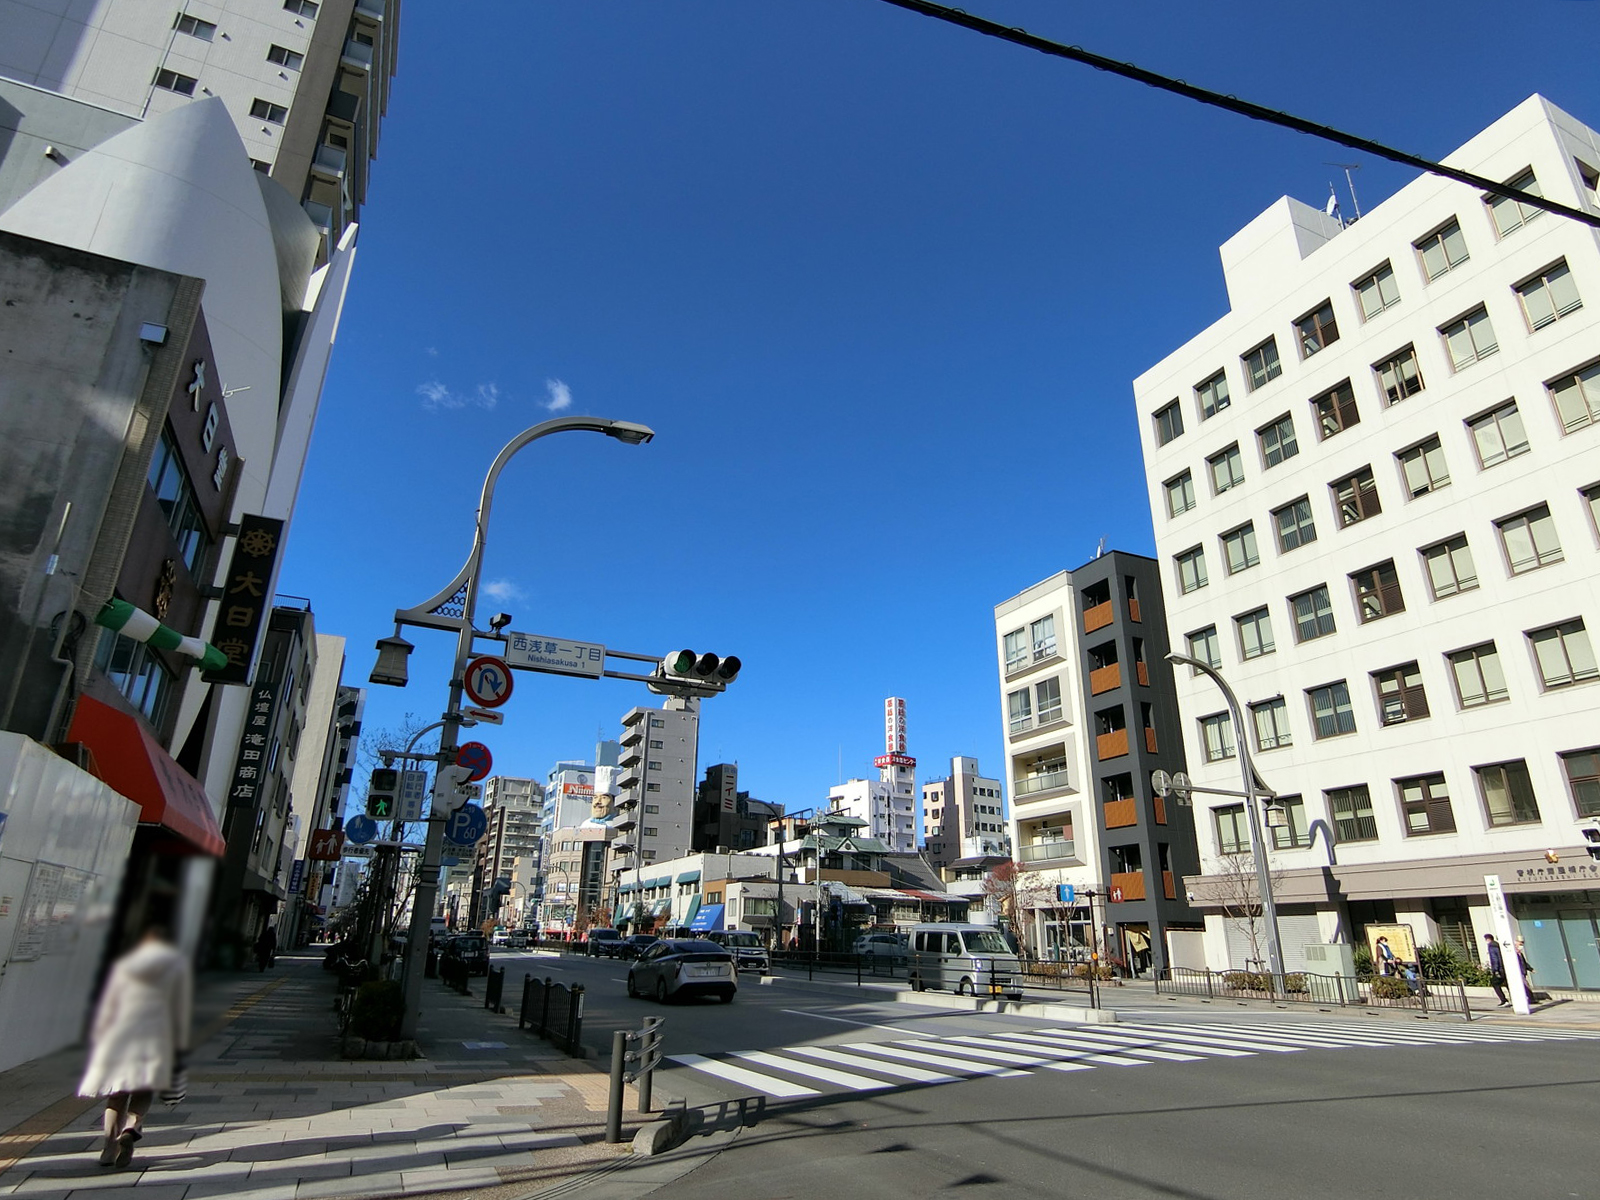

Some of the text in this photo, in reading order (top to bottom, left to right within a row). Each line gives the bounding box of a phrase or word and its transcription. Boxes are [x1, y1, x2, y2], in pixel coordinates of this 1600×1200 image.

[217, 571, 262, 667] 大日堂
[513, 637, 601, 661] 西浅草一丁目
[527, 654, 578, 668] Nishiasakusa
[233, 689, 272, 798] 仏壇屋 滝田商店
[724, 775, 734, 809] ニイミ
[452, 812, 477, 840] P 60
[343, 846, 370, 855] 歩行者優先
